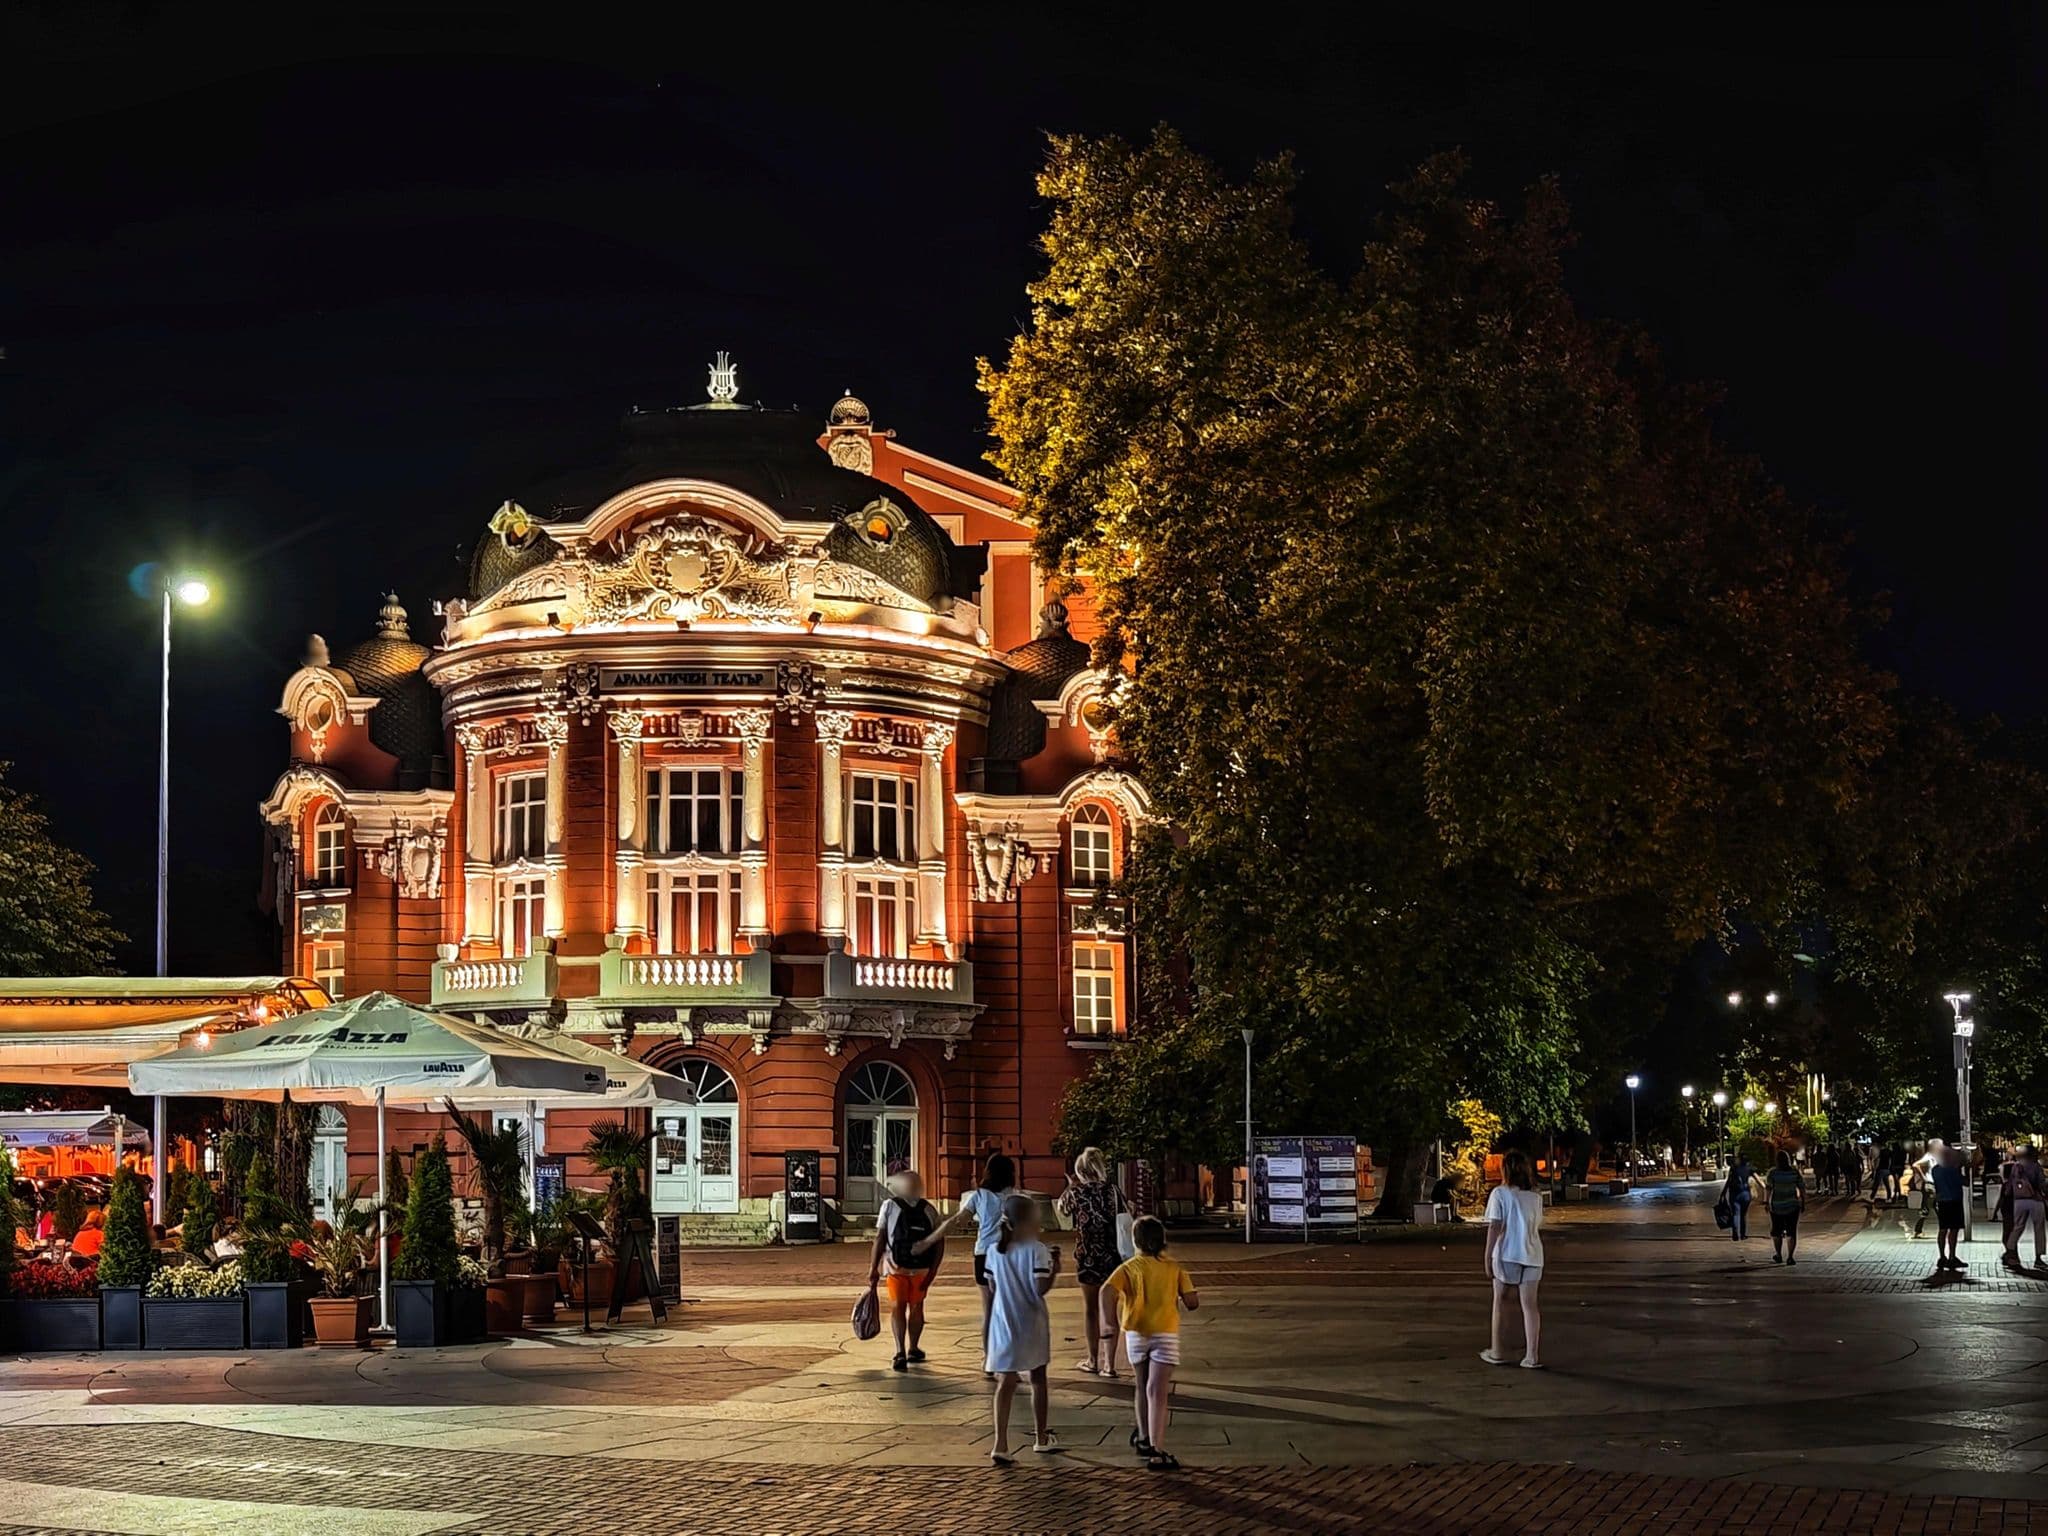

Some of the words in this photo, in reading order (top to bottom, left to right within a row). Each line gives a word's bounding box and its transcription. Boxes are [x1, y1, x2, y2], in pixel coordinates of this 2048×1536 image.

[613, 673, 707, 687] ДРАМАТИЧЕН
[711, 673, 764, 686] ТЕАТЪР
[256, 1027, 409, 1047] LAVAZZA
[423, 1062, 466, 1073] LAVAZZA
